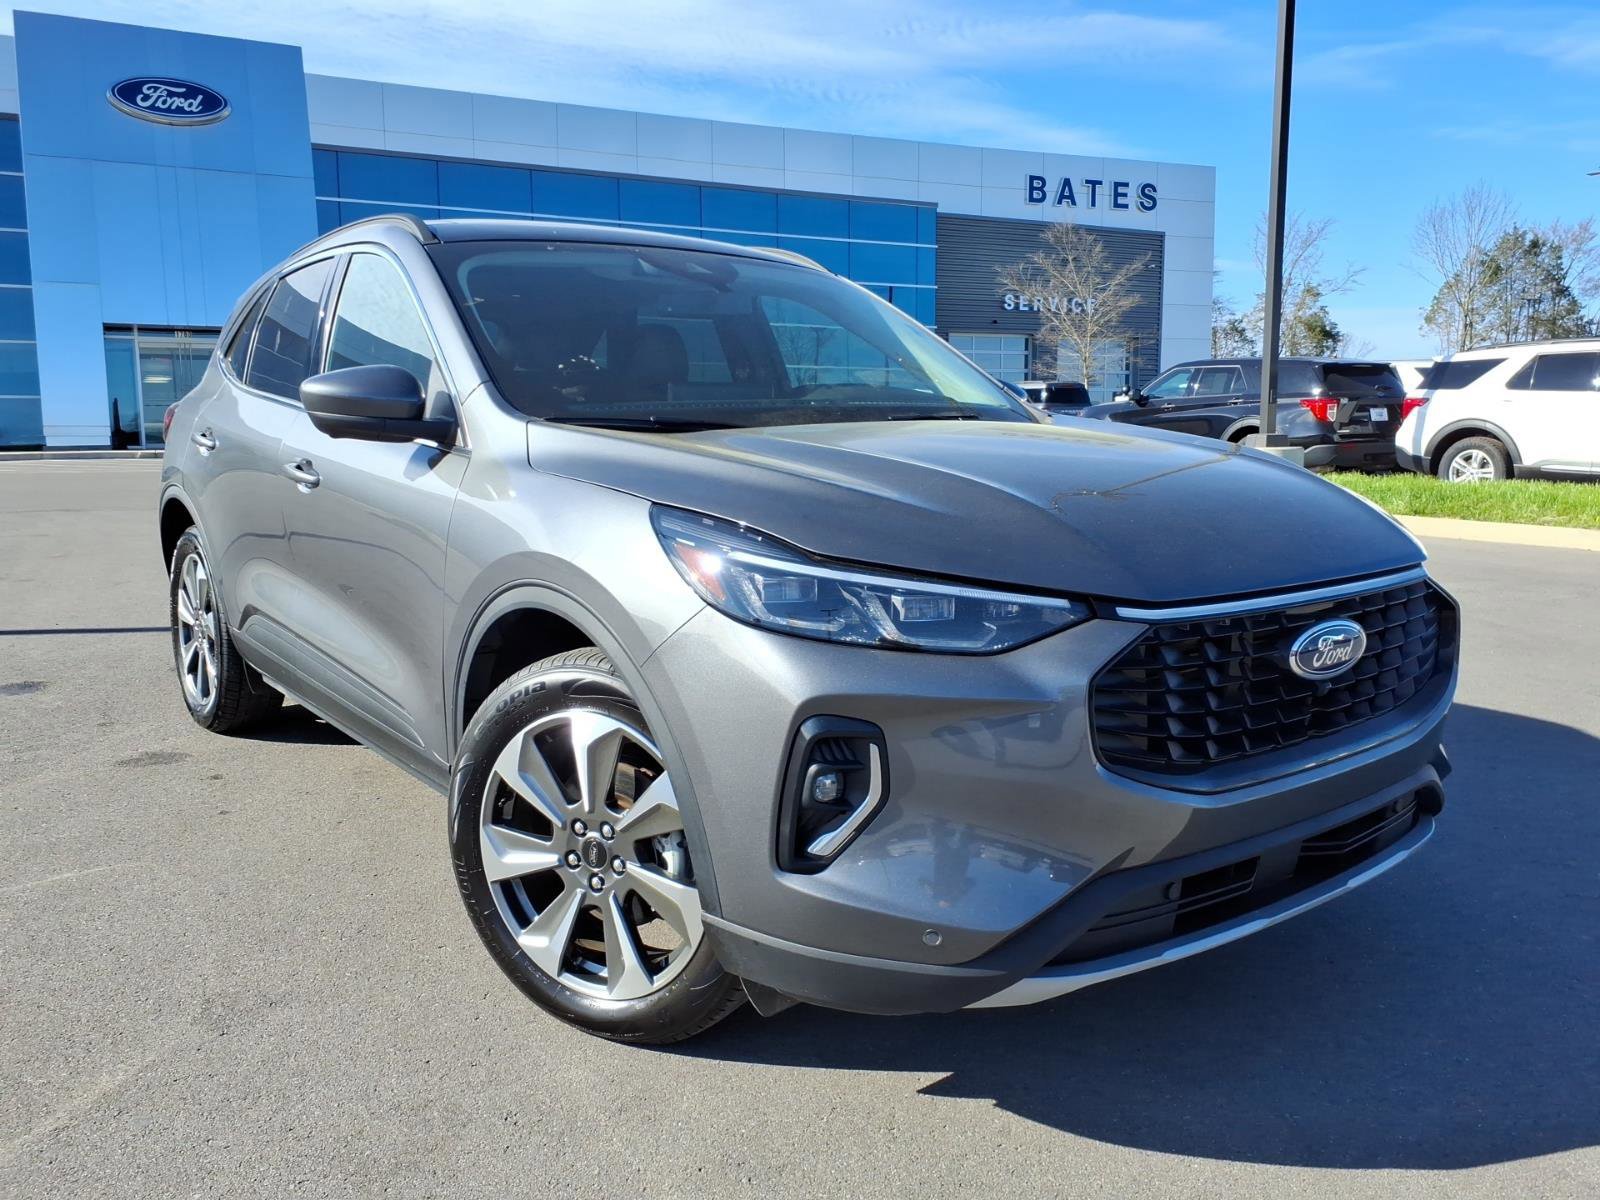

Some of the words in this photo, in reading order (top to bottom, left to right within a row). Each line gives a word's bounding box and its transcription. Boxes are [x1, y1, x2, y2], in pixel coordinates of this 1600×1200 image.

[136, 83, 204, 112] Ford
[1027, 174, 1158, 212] BATES
[1313, 633, 1354, 668] Ford
